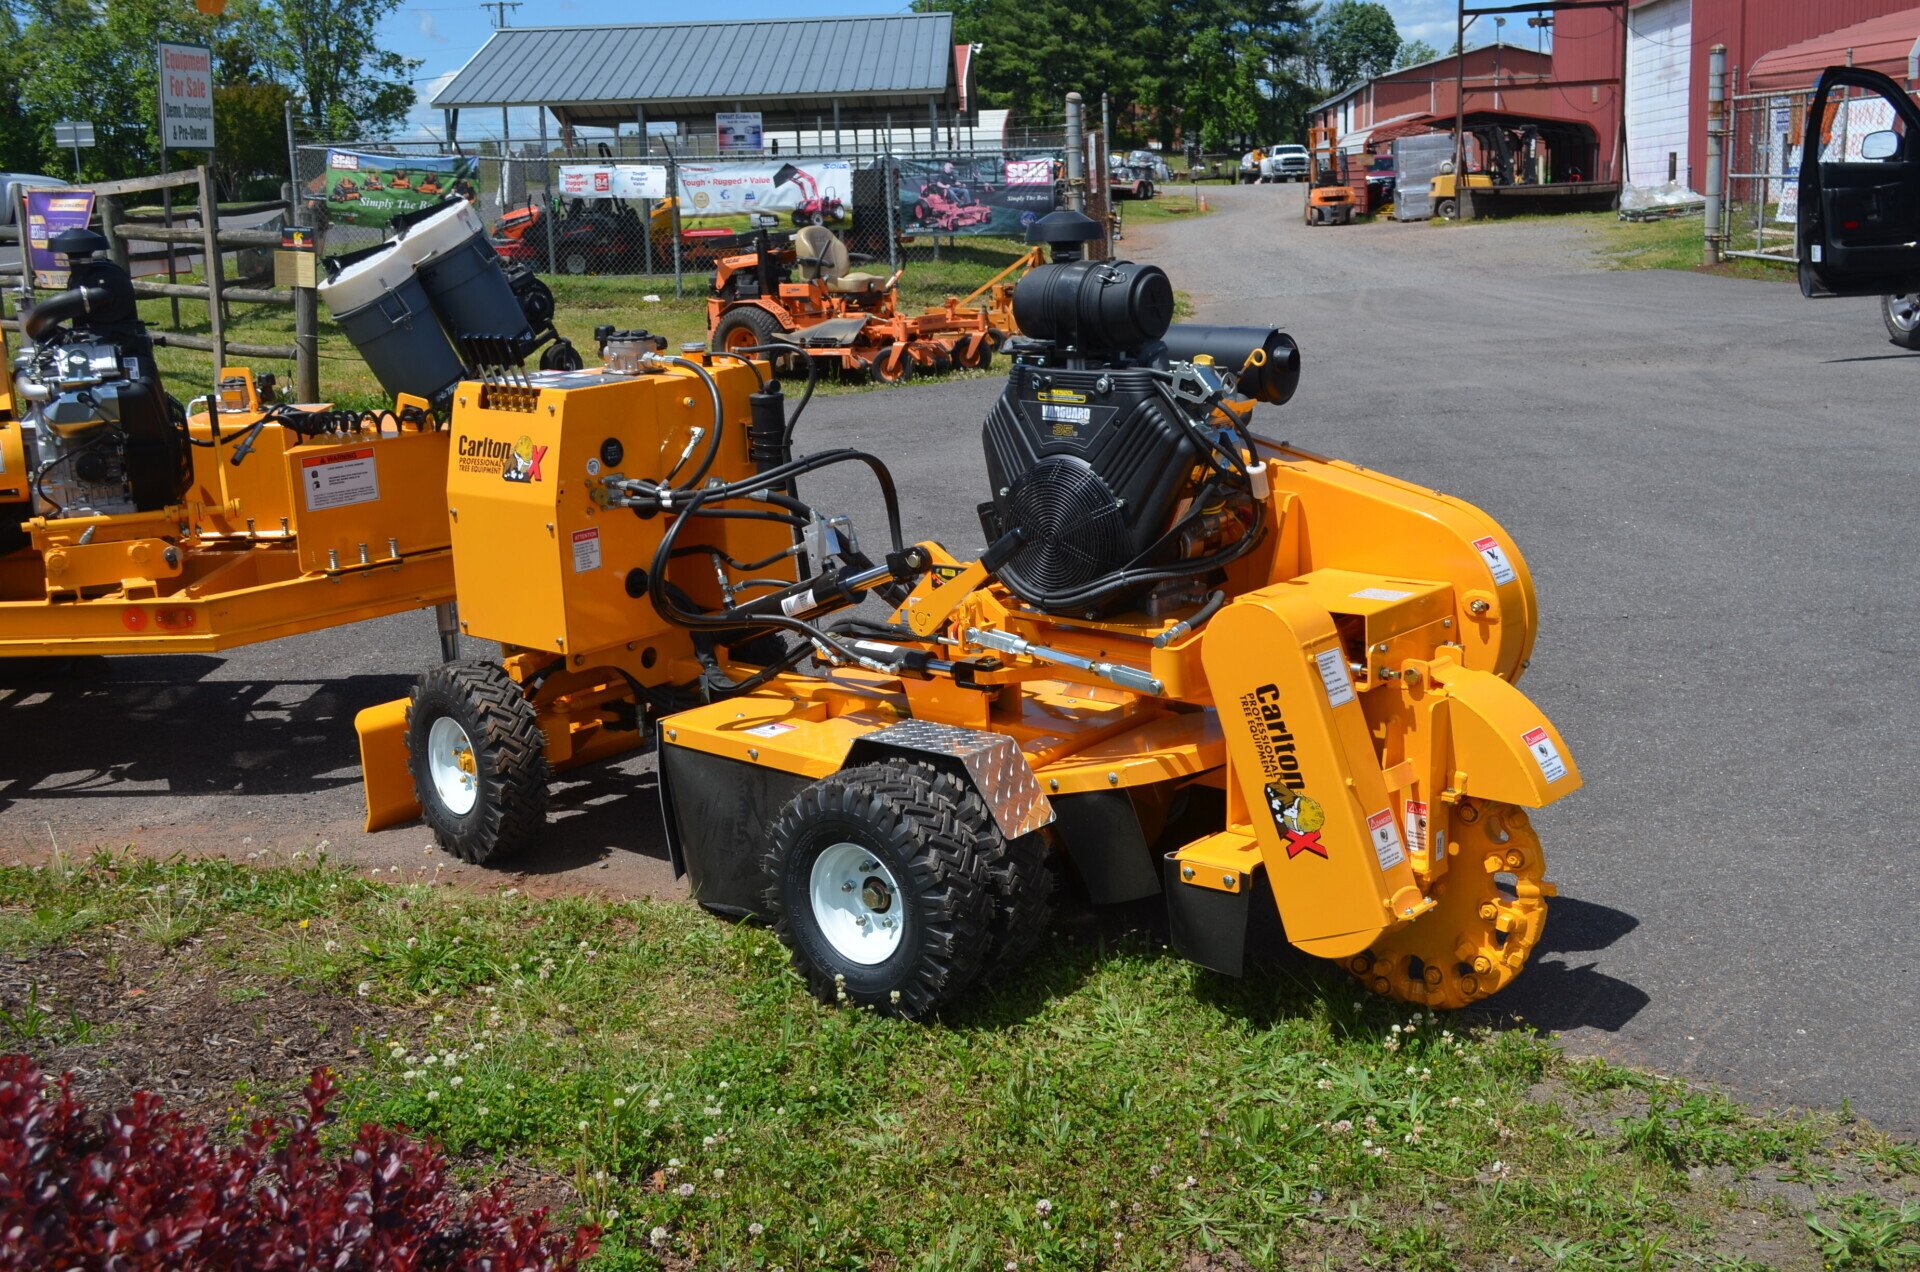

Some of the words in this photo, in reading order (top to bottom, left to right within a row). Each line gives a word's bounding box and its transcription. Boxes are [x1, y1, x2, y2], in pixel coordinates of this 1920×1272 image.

[164, 49, 208, 72] Equipment
[169, 75, 183, 97] For
[187, 77, 206, 98] Sale
[178, 125, 207, 140] Pre-Owned
[332, 155, 358, 165] SCAG
[1007, 163, 1048, 178] SCAG
[596, 179, 608, 187] 84
[359, 197, 393, 210] Simply
[397, 200, 415, 209] The
[1042, 405, 1090, 419] VANGUARD
[1053, 424, 1073, 436] 35
[458, 435, 512, 460] Carlton
[328, 453, 357, 462] WARNING
[459, 457, 504, 467] PROFESSIONAL
[459, 464, 470, 473] TREE
[471, 465, 501, 475] EQUIPMENT
[574, 531, 598, 541] ATTENTION
[1240, 695, 1252, 719] TREE
[1248, 719, 1274, 778] EQUIPMENT
[1247, 693, 1281, 777] PROFESSIONAL
[1255, 683, 1305, 790] Carlton
